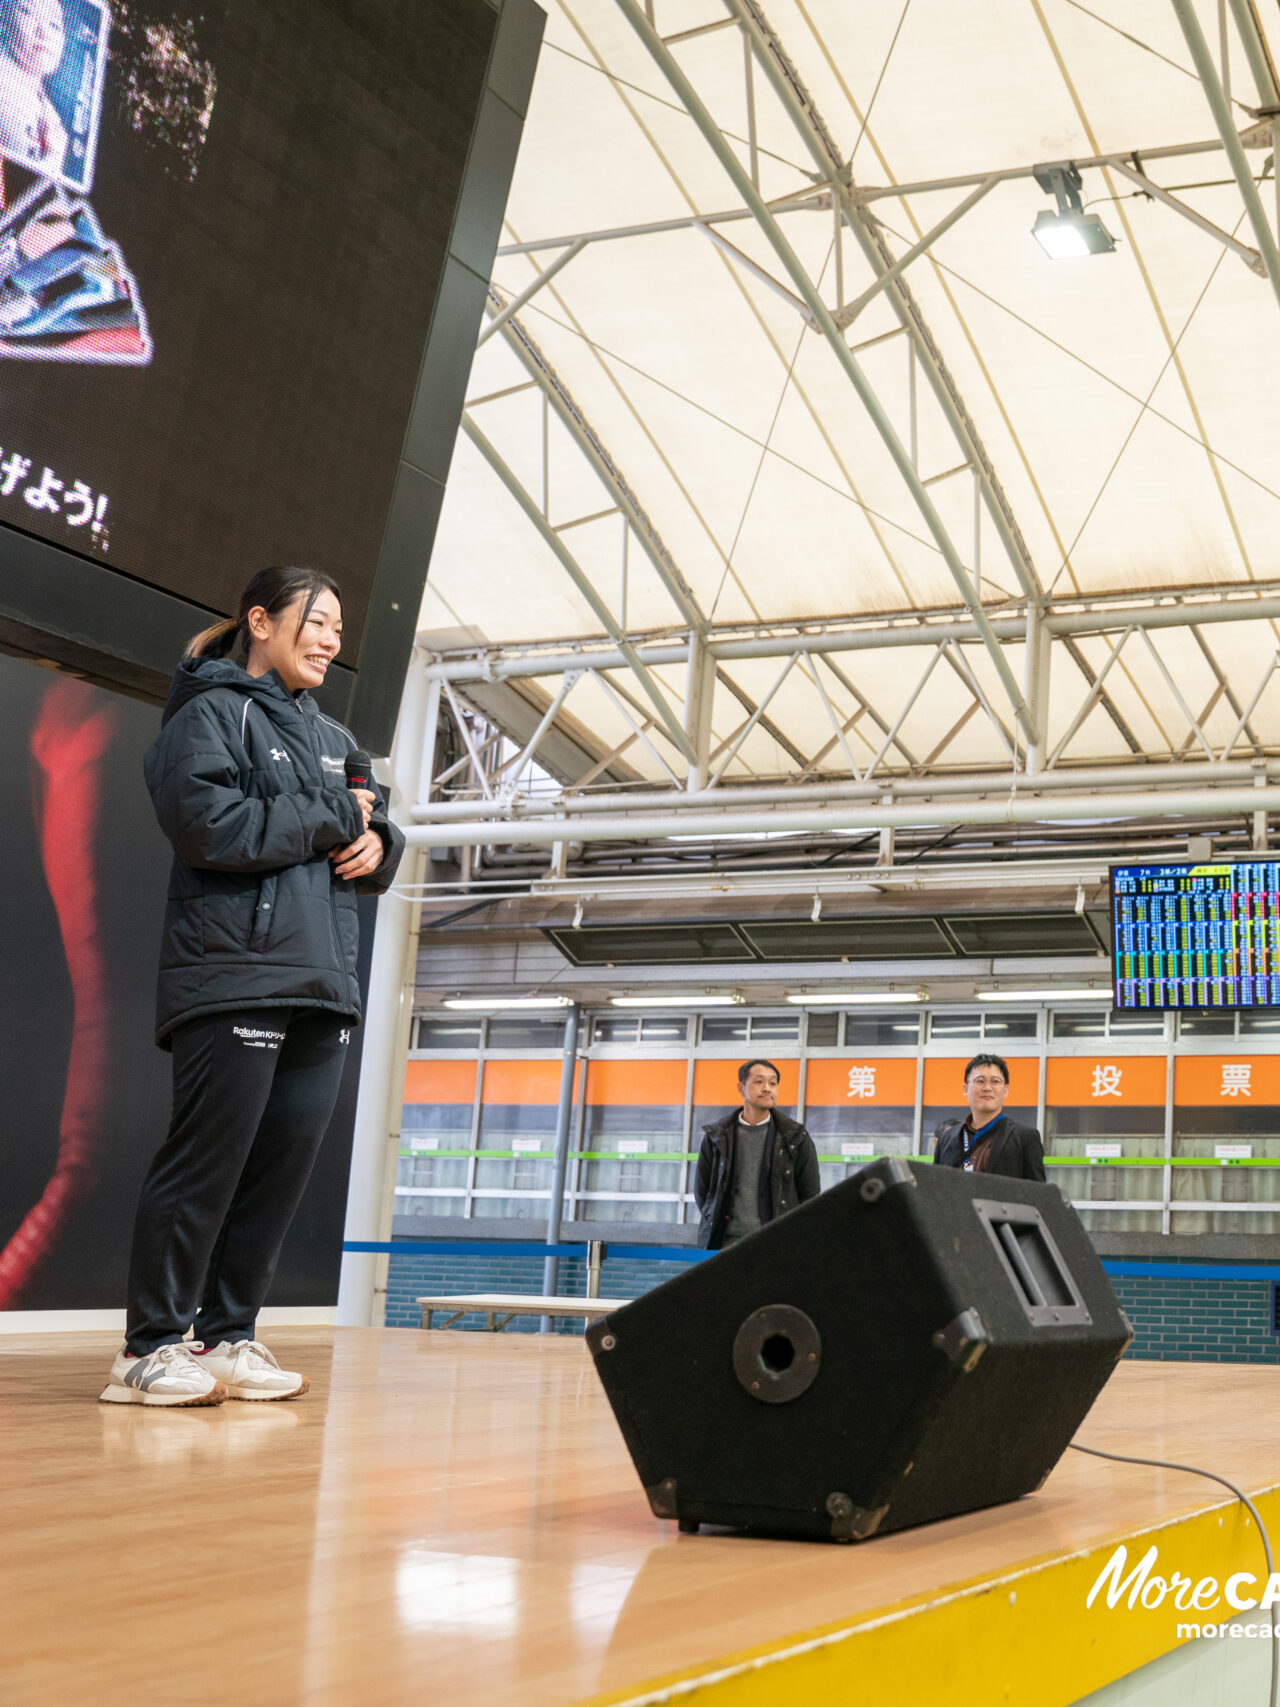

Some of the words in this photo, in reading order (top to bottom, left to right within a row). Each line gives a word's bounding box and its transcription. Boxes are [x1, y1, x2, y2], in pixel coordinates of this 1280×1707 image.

[233, 1026, 265, 1038] Rakuten
[848, 1066, 876, 1099] 第
[1091, 1065, 1122, 1096] 投
[1220, 1065, 1251, 1096] 票
